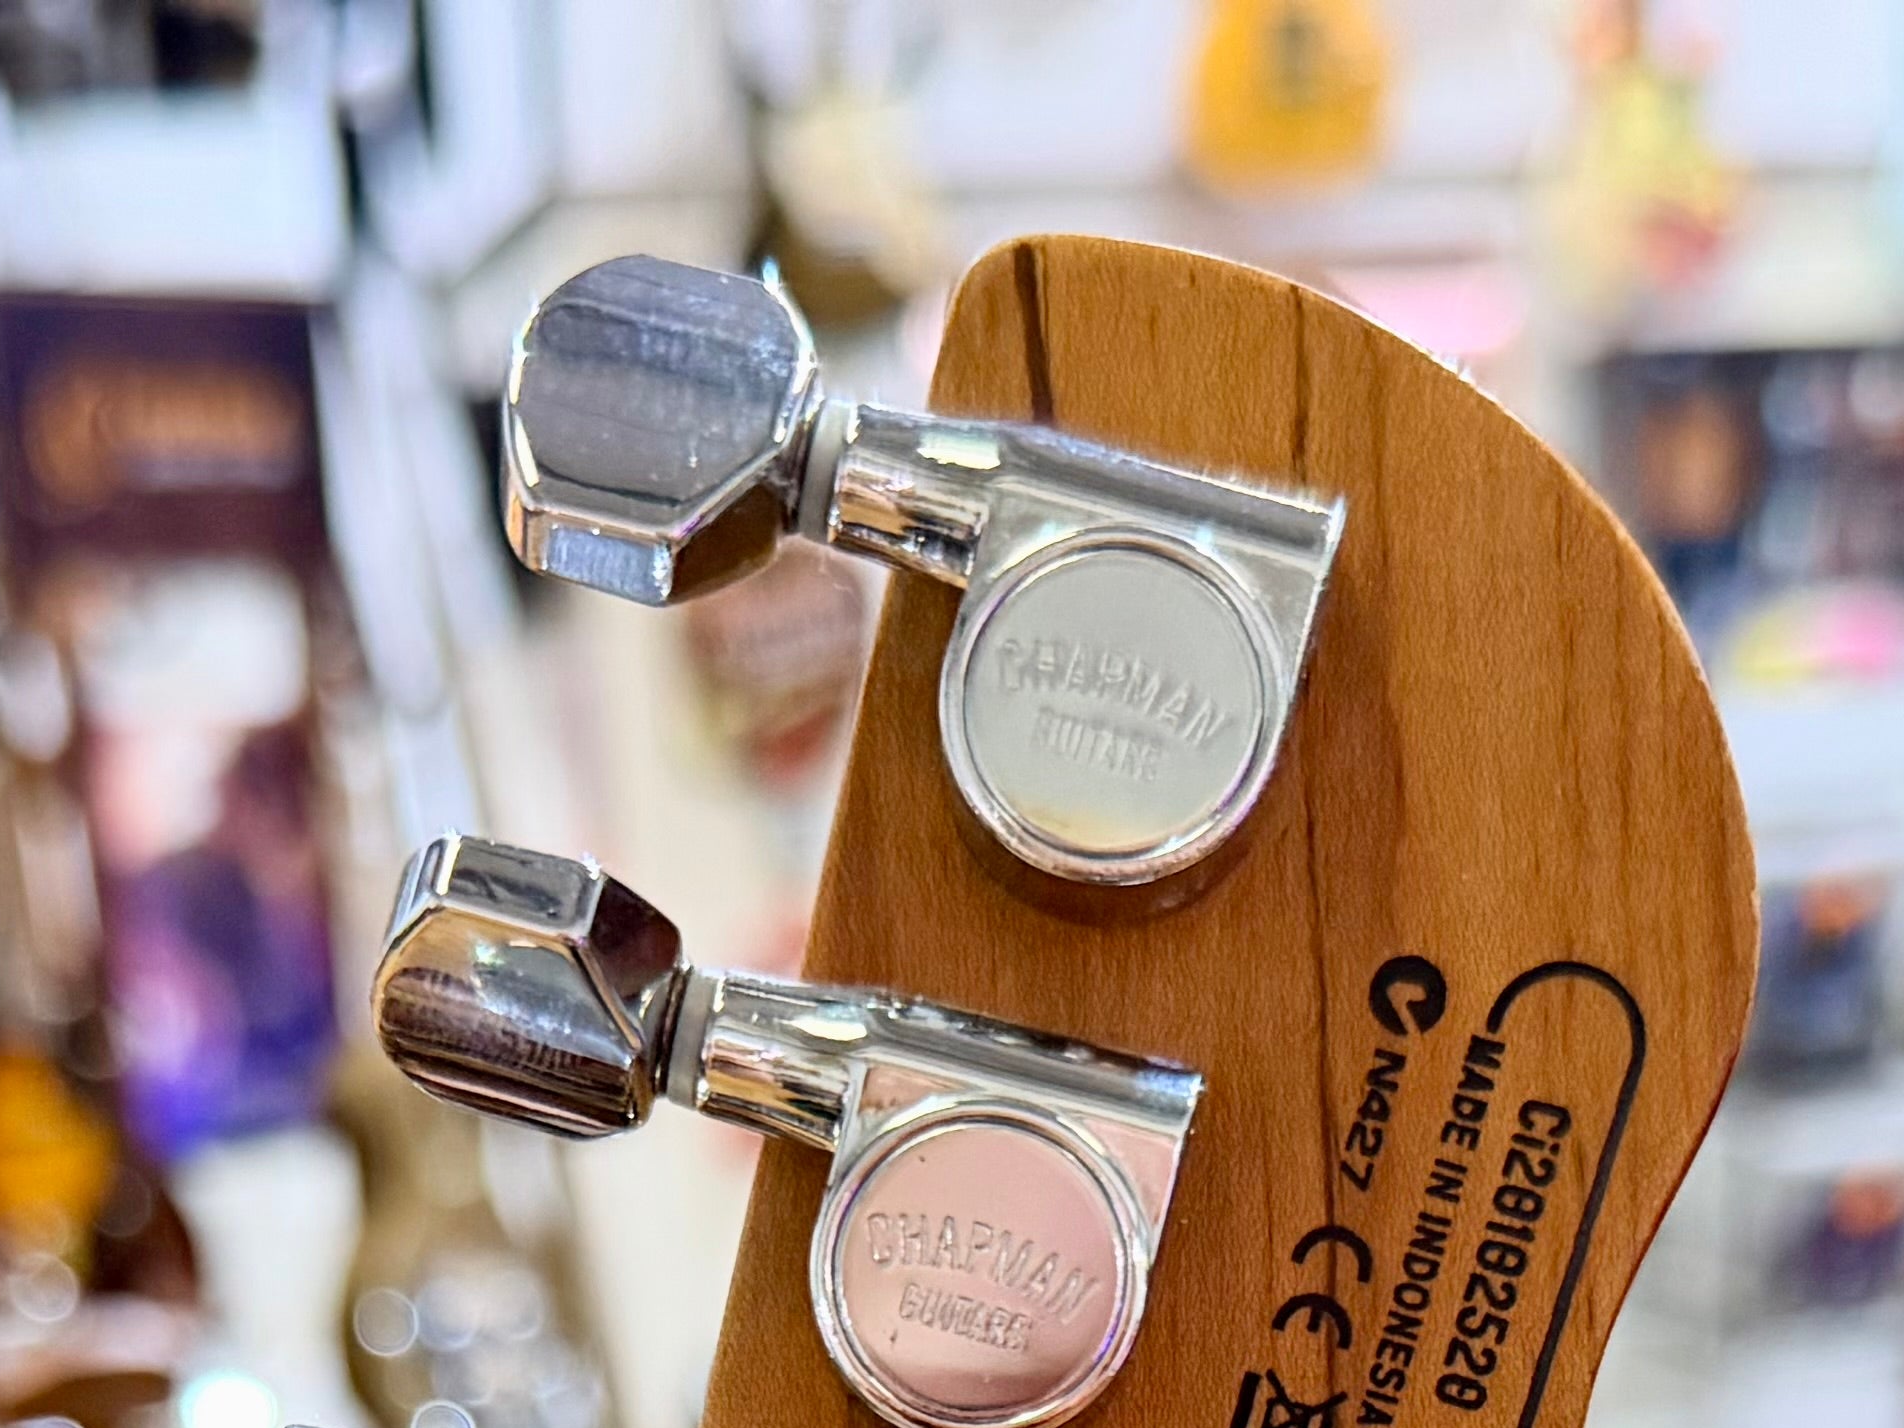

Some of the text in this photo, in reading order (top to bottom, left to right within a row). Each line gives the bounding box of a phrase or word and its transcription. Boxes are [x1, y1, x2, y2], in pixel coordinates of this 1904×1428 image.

[1000, 637, 1227, 746] CHAPMAN
[1339, 1047, 1407, 1193] N427
[866, 1212, 1100, 1326] CHAPMAN
[1356, 1033, 1506, 1427] MADE IN INDONESIA
[898, 1281, 1034, 1351] GUITARS
